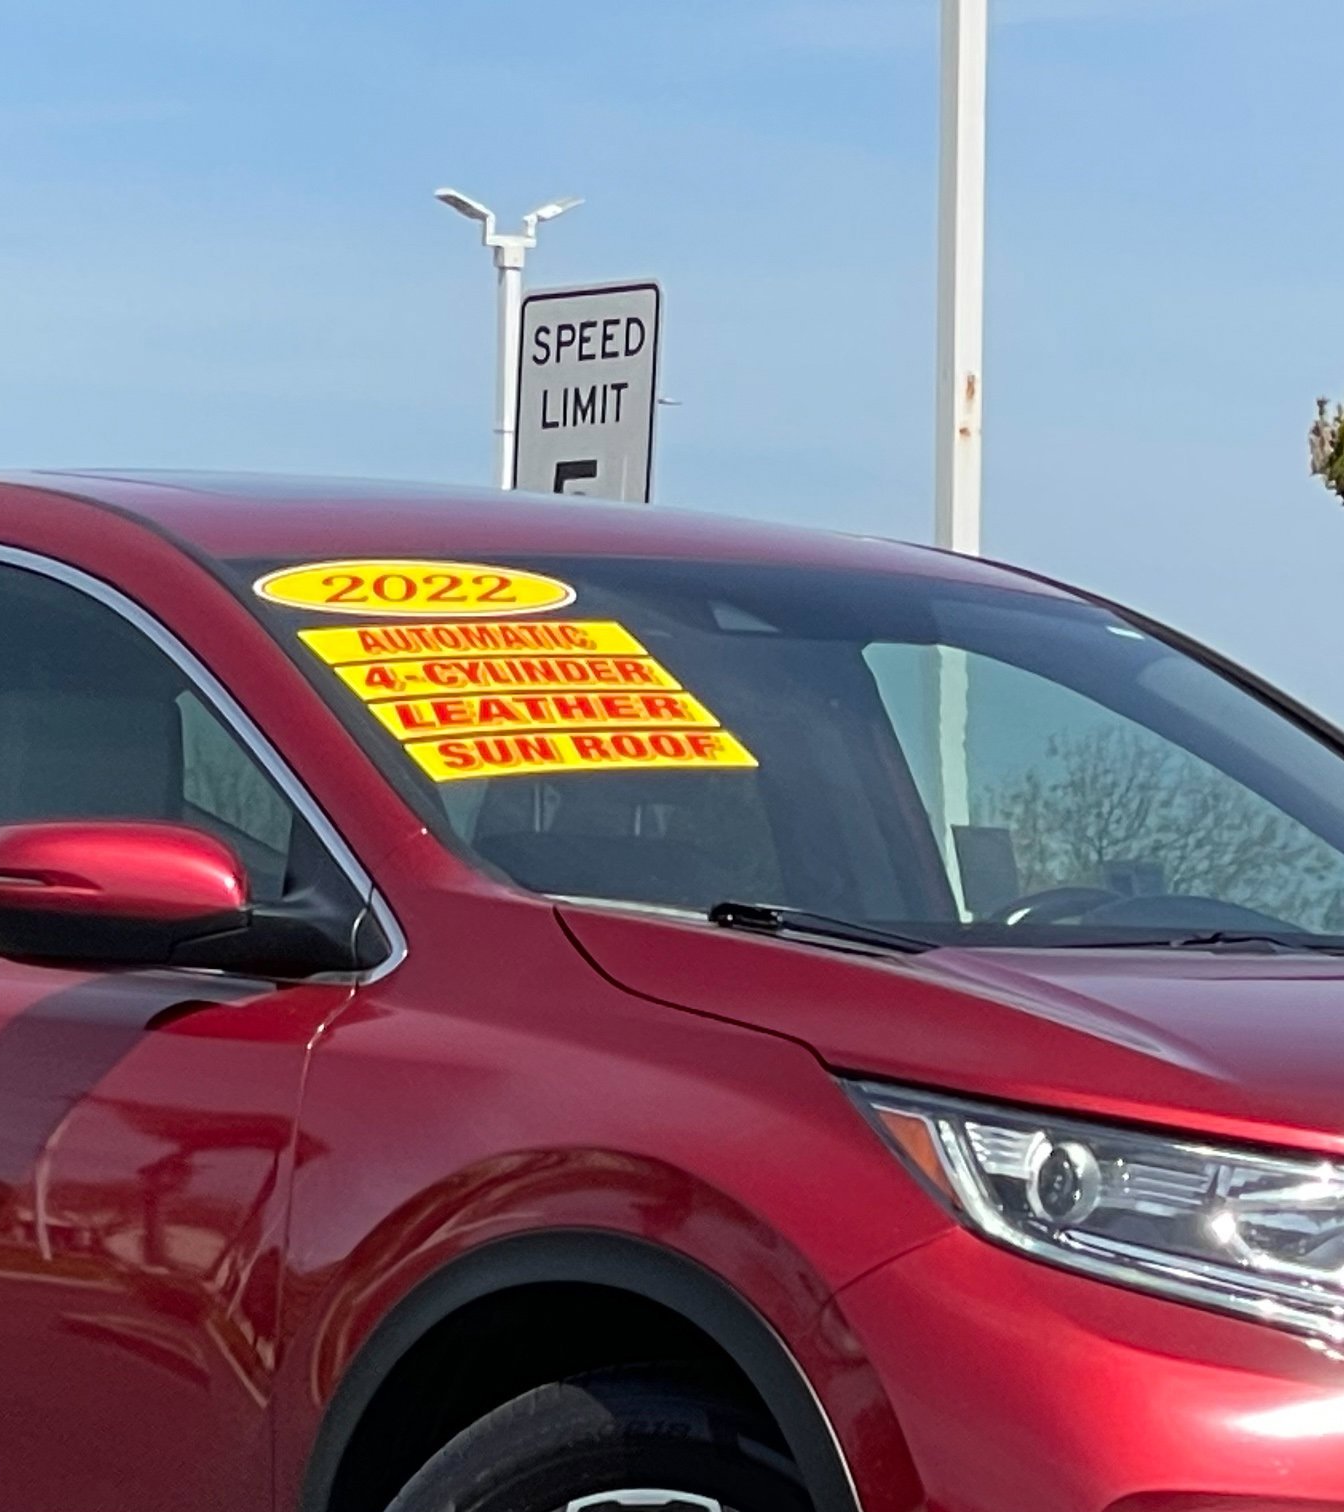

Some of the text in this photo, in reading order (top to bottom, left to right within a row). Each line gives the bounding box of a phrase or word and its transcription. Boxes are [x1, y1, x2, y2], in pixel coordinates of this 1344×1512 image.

[532, 317, 646, 365] SPEED
[541, 382, 628, 429] LIMIT
[321, 574, 517, 603] 2022
[358, 622, 595, 655] AUTOMATIC
[365, 658, 658, 692] 4-CYLINDER
[396, 695, 692, 730] LEATHER
[438, 733, 726, 770] SUN ROOF
